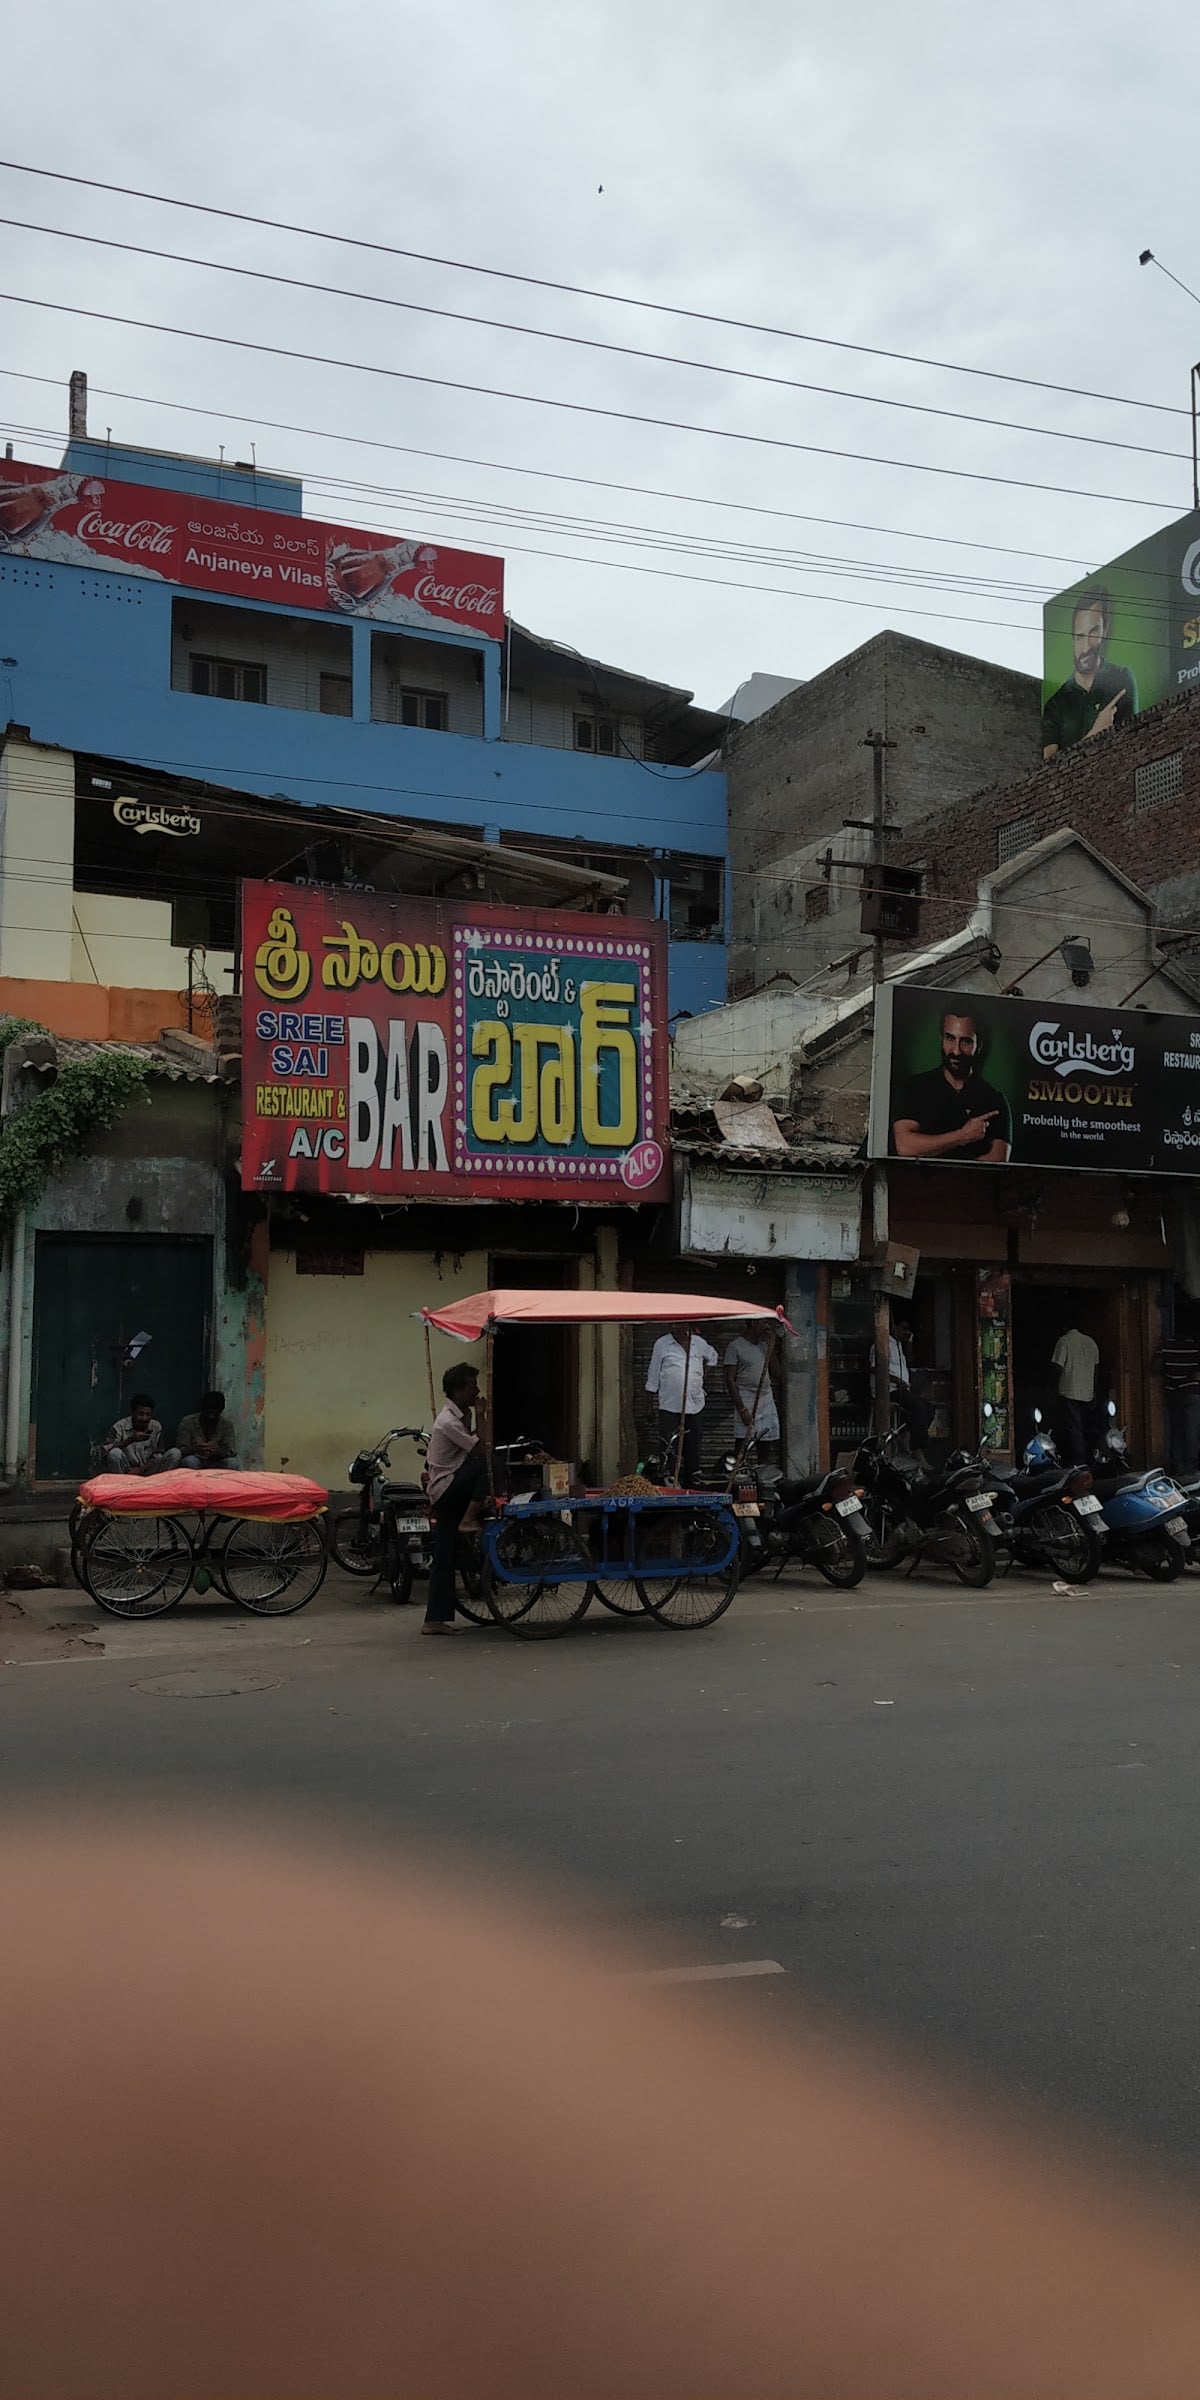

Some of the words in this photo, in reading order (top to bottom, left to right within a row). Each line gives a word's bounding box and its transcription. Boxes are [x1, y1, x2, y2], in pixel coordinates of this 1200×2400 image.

[77, 511, 178, 555] Coca-Cola
[187, 519, 265, 546] ఆంజనేయ
[272, 533, 321, 556] విలాస్
[185, 547, 273, 580] Anjaneya
[279, 564, 323, 588] Vilas
[413, 575, 500, 617] Coca-Cola
[113, 796, 201, 836] Carlsberg
[254, 907, 312, 1000] శ్రీ
[321, 921, 448, 994] సాయి
[272, 1046, 329, 1077] SAI
[471, 980, 637, 1147] బార్
[1029, 1020, 1136, 1078] Carlsberg
[256, 1011, 345, 1045] SREE
[347, 1016, 450, 1173] BAR
[256, 1085, 334, 1118] RESTAURANT
[338, 1089, 346, 1119] &
[1027, 1080, 1134, 1107] SMOOTH
[1023, 1113, 1070, 1130] Probably
[1071, 1116, 1089, 1129] the
[1089, 1118, 1141, 1132] smoothest
[1069, 1131, 1082, 1140] the
[288, 1128, 345, 1160] A/C
[628, 1149, 657, 1180] A/C
